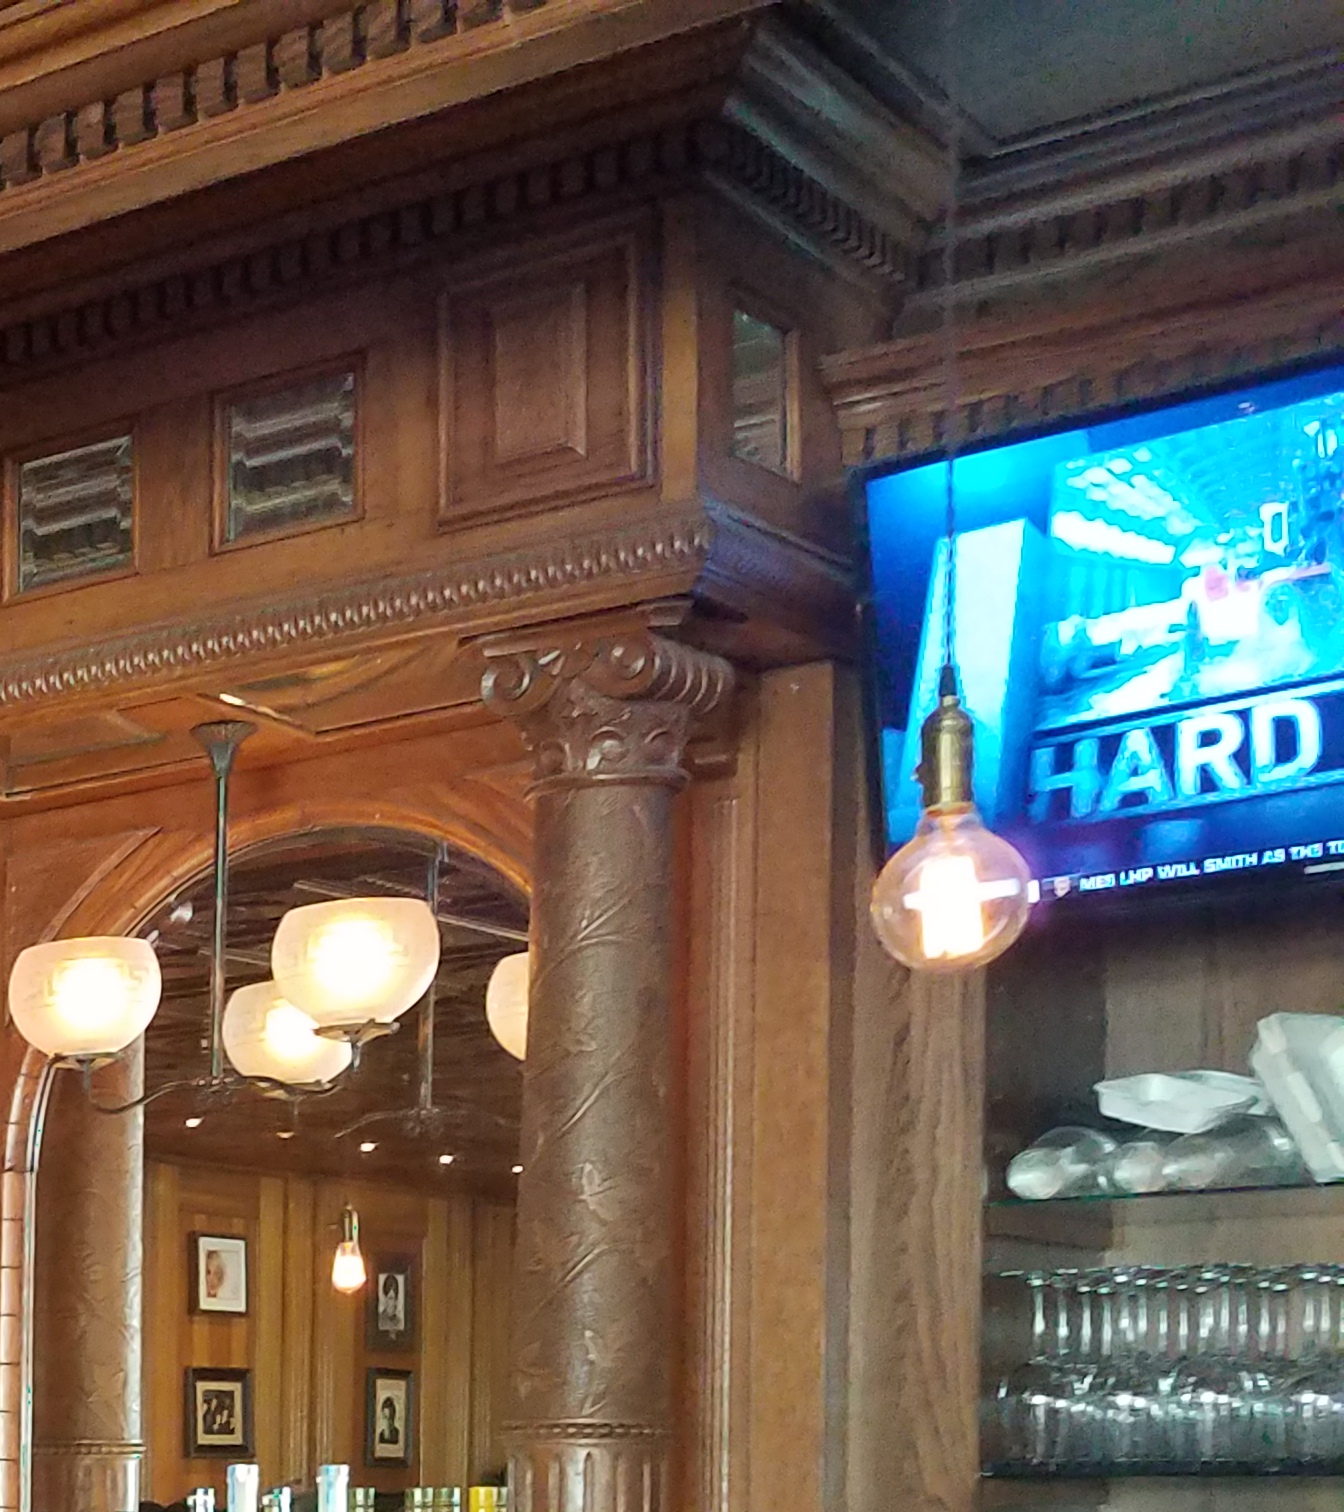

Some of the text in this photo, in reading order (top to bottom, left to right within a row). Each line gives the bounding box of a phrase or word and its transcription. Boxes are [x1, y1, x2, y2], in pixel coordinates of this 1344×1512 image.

[1029, 699, 1323, 820] HARD
[1157, 862, 1199, 880] WILL
[1203, 852, 1258, 872] SMITH
[1261, 849, 1285, 864] AS
[1289, 843, 1323, 860] THE
